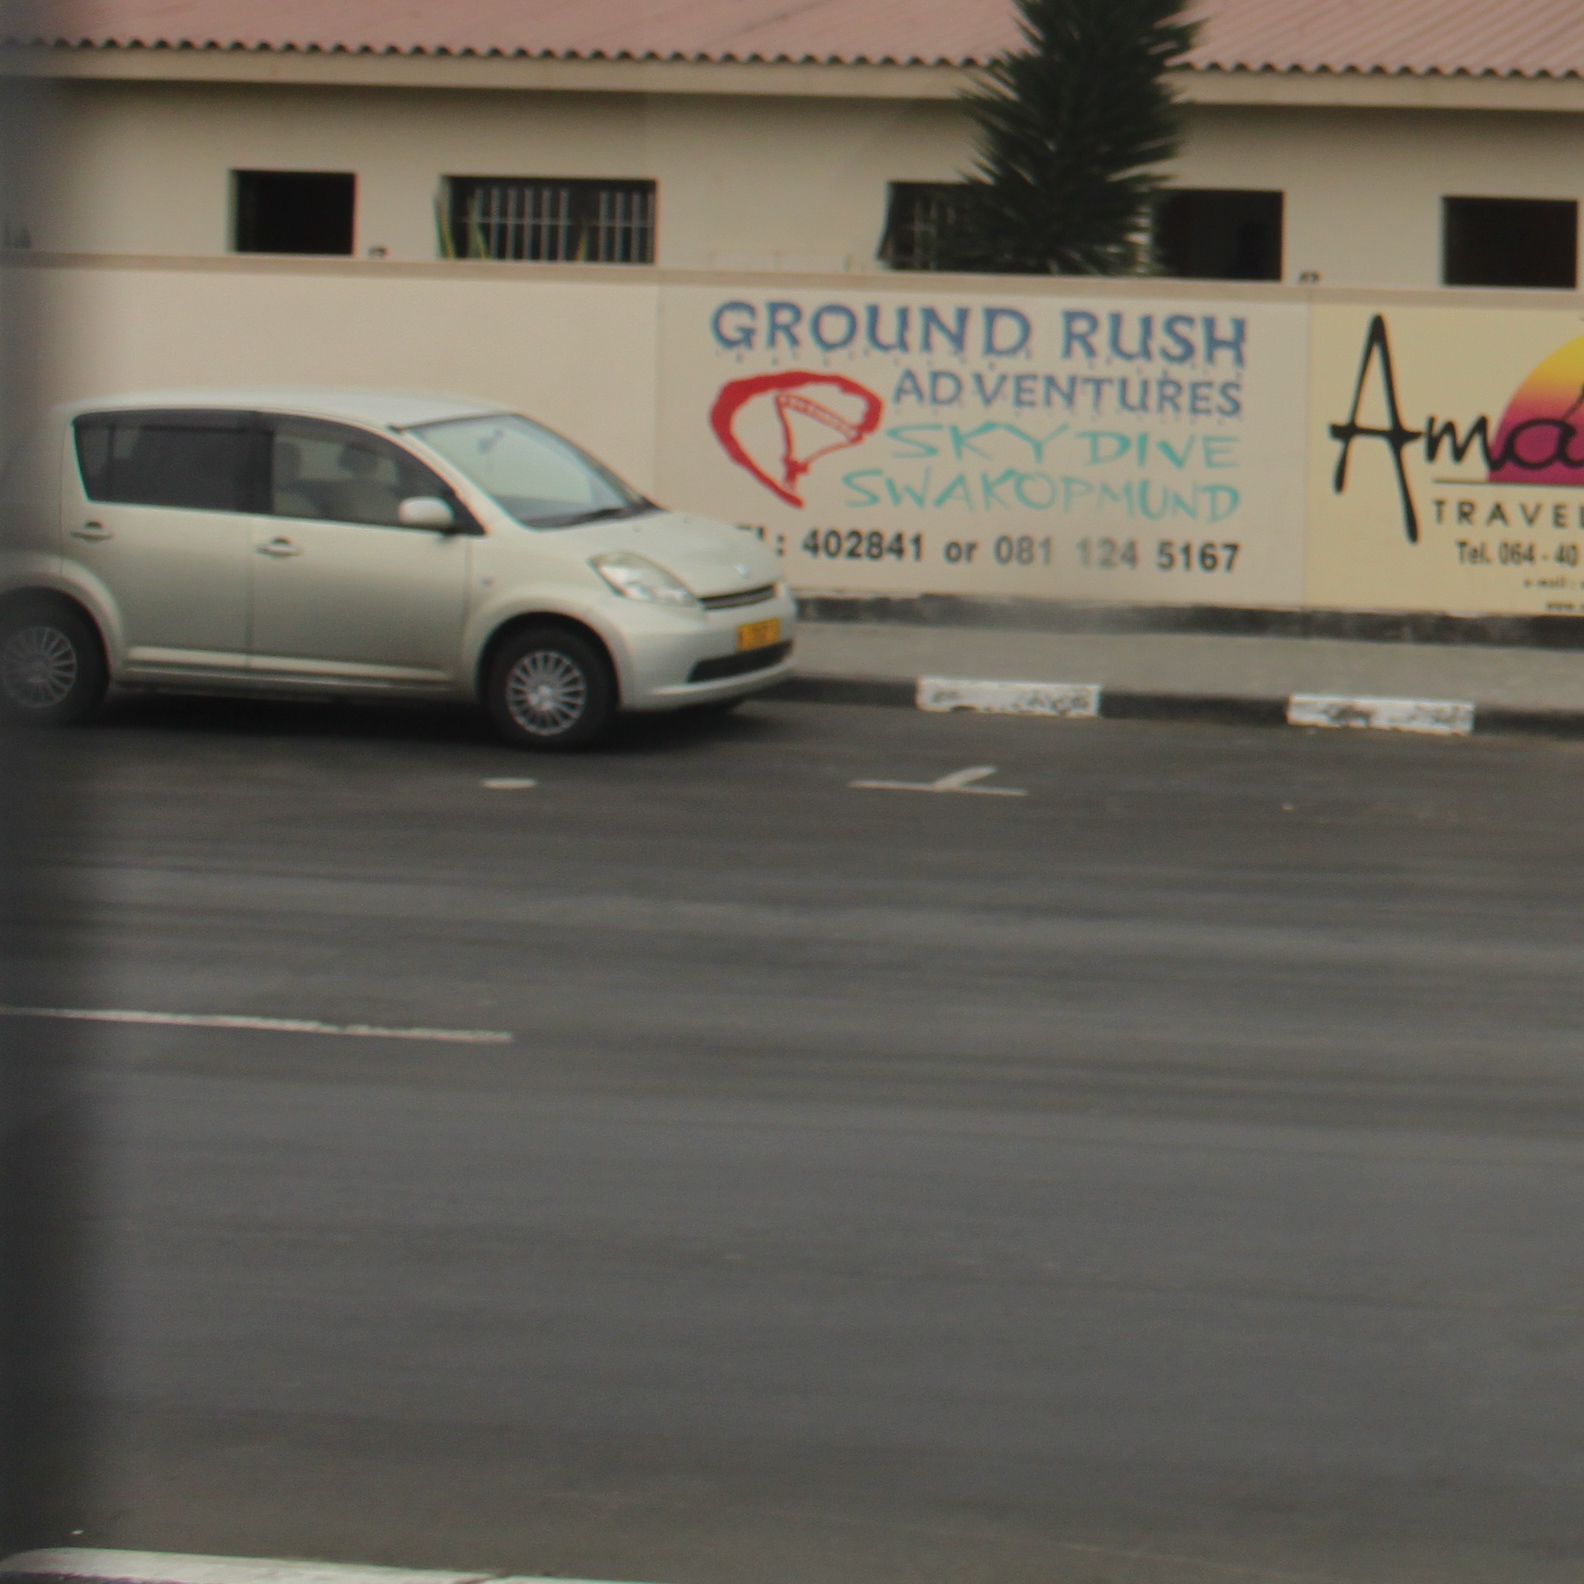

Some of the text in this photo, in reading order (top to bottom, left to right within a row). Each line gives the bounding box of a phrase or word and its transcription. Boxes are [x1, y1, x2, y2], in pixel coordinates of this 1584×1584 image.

[709, 301, 1247, 369] GROUND RUSH
[893, 368, 1242, 418] ADVENTURES
[841, 466, 1241, 523] SWAKOPMUND
[801, 529, 925, 563] 402841
[944, 537, 978, 564] or
[993, 535, 1053, 566] 081
[1075, 536, 1139, 570] 124
[1156, 540, 1241, 574] 5167
[1455, 541, 1491, 566] Tel.
[1498, 543, 1536, 567] 064
[1555, 544, 1578, 568] 40
